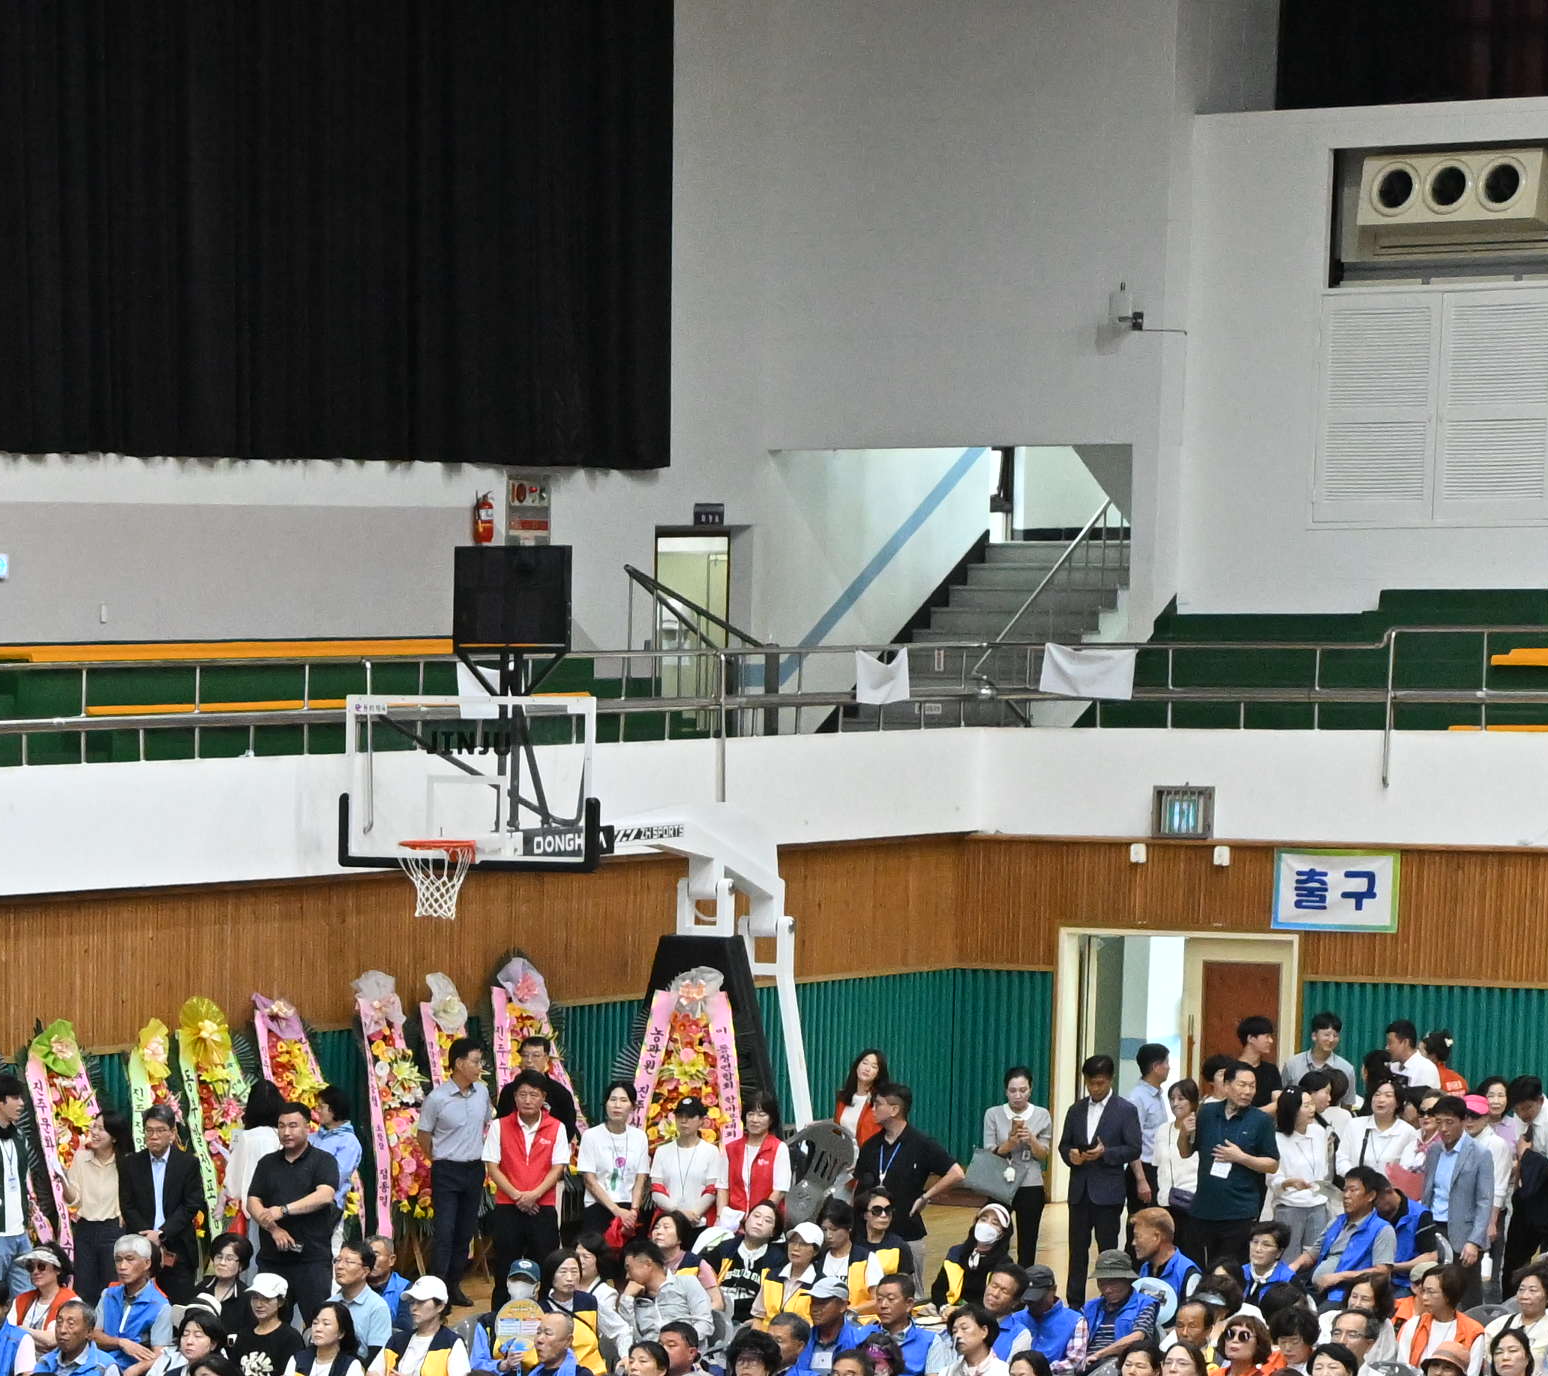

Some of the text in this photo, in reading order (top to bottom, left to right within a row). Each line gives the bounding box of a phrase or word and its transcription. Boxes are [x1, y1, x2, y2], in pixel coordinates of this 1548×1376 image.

[425, 730, 513, 755] JINJU
[533, 830, 611, 856] DONGHA
[1293, 868, 1378, 912] 출구
[30, 1078, 56, 1151] 진주문화
